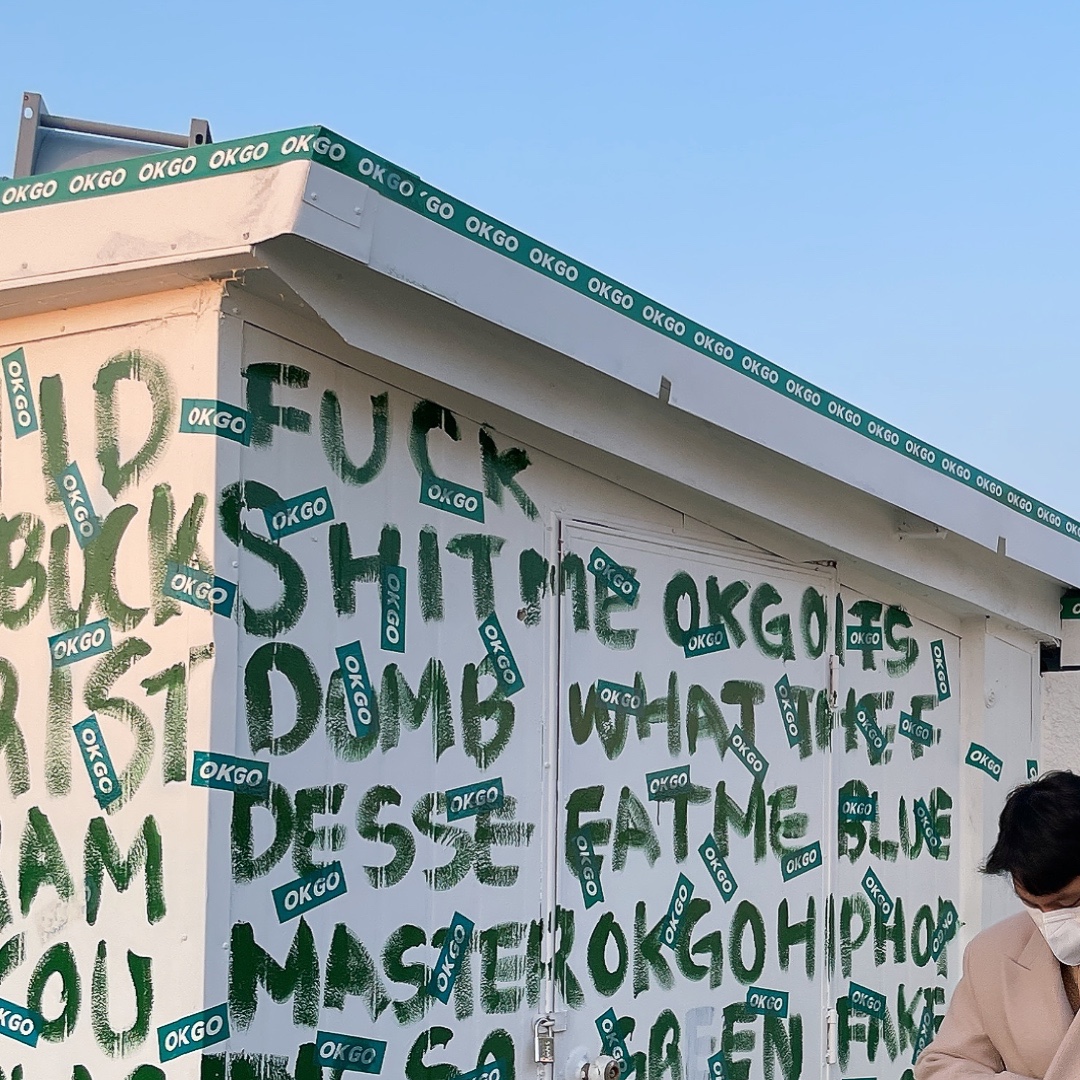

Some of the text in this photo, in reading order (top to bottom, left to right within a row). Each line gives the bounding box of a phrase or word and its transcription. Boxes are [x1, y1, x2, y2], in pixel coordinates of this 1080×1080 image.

[2, 134, 347, 204] OKGO OKGO OKGO OKGO OKGO
[465, 216, 519, 253] OKGO
[529, 247, 579, 282] OKGO
[588, 277, 634, 310] OKGO
[642, 305, 685, 336] OKGO
[694, 331, 734, 361] OKGO
[741, 355, 779, 384] OKGO
[786, 379, 821, 406] OKGO
[827, 401, 861, 427] OKGO
[867, 421, 899, 446] OKGO
[905, 440, 936, 464] OKGO
[941, 458, 971, 481] OKGO
[976, 475, 1002, 497] OKGO
[1007, 491, 1032, 513] OKGO
[1037, 507, 1061, 527] OKGO
[8, 361, 31, 427] OKGO
[187, 407, 246, 434] OKGO
[241, 362, 540, 521] FUCK
[62, 475, 93, 538] OKGO
[272, 497, 327, 530] OKGO
[427, 484, 478, 512] OKGO
[664, 571, 827, 662] OKGO
[344, 655, 372, 725] OKGO
[600, 687, 641, 709] OKGO
[199, 759, 262, 787] OKGO
[970, 749, 1001, 775] OKGO
[650, 772, 688, 794] OKGO
[785, 850, 819, 871] OKGO
[284, 872, 340, 911] OKGO
[750, 994, 783, 1011] OKGO
[164, 1016, 224, 1052] OKGO
